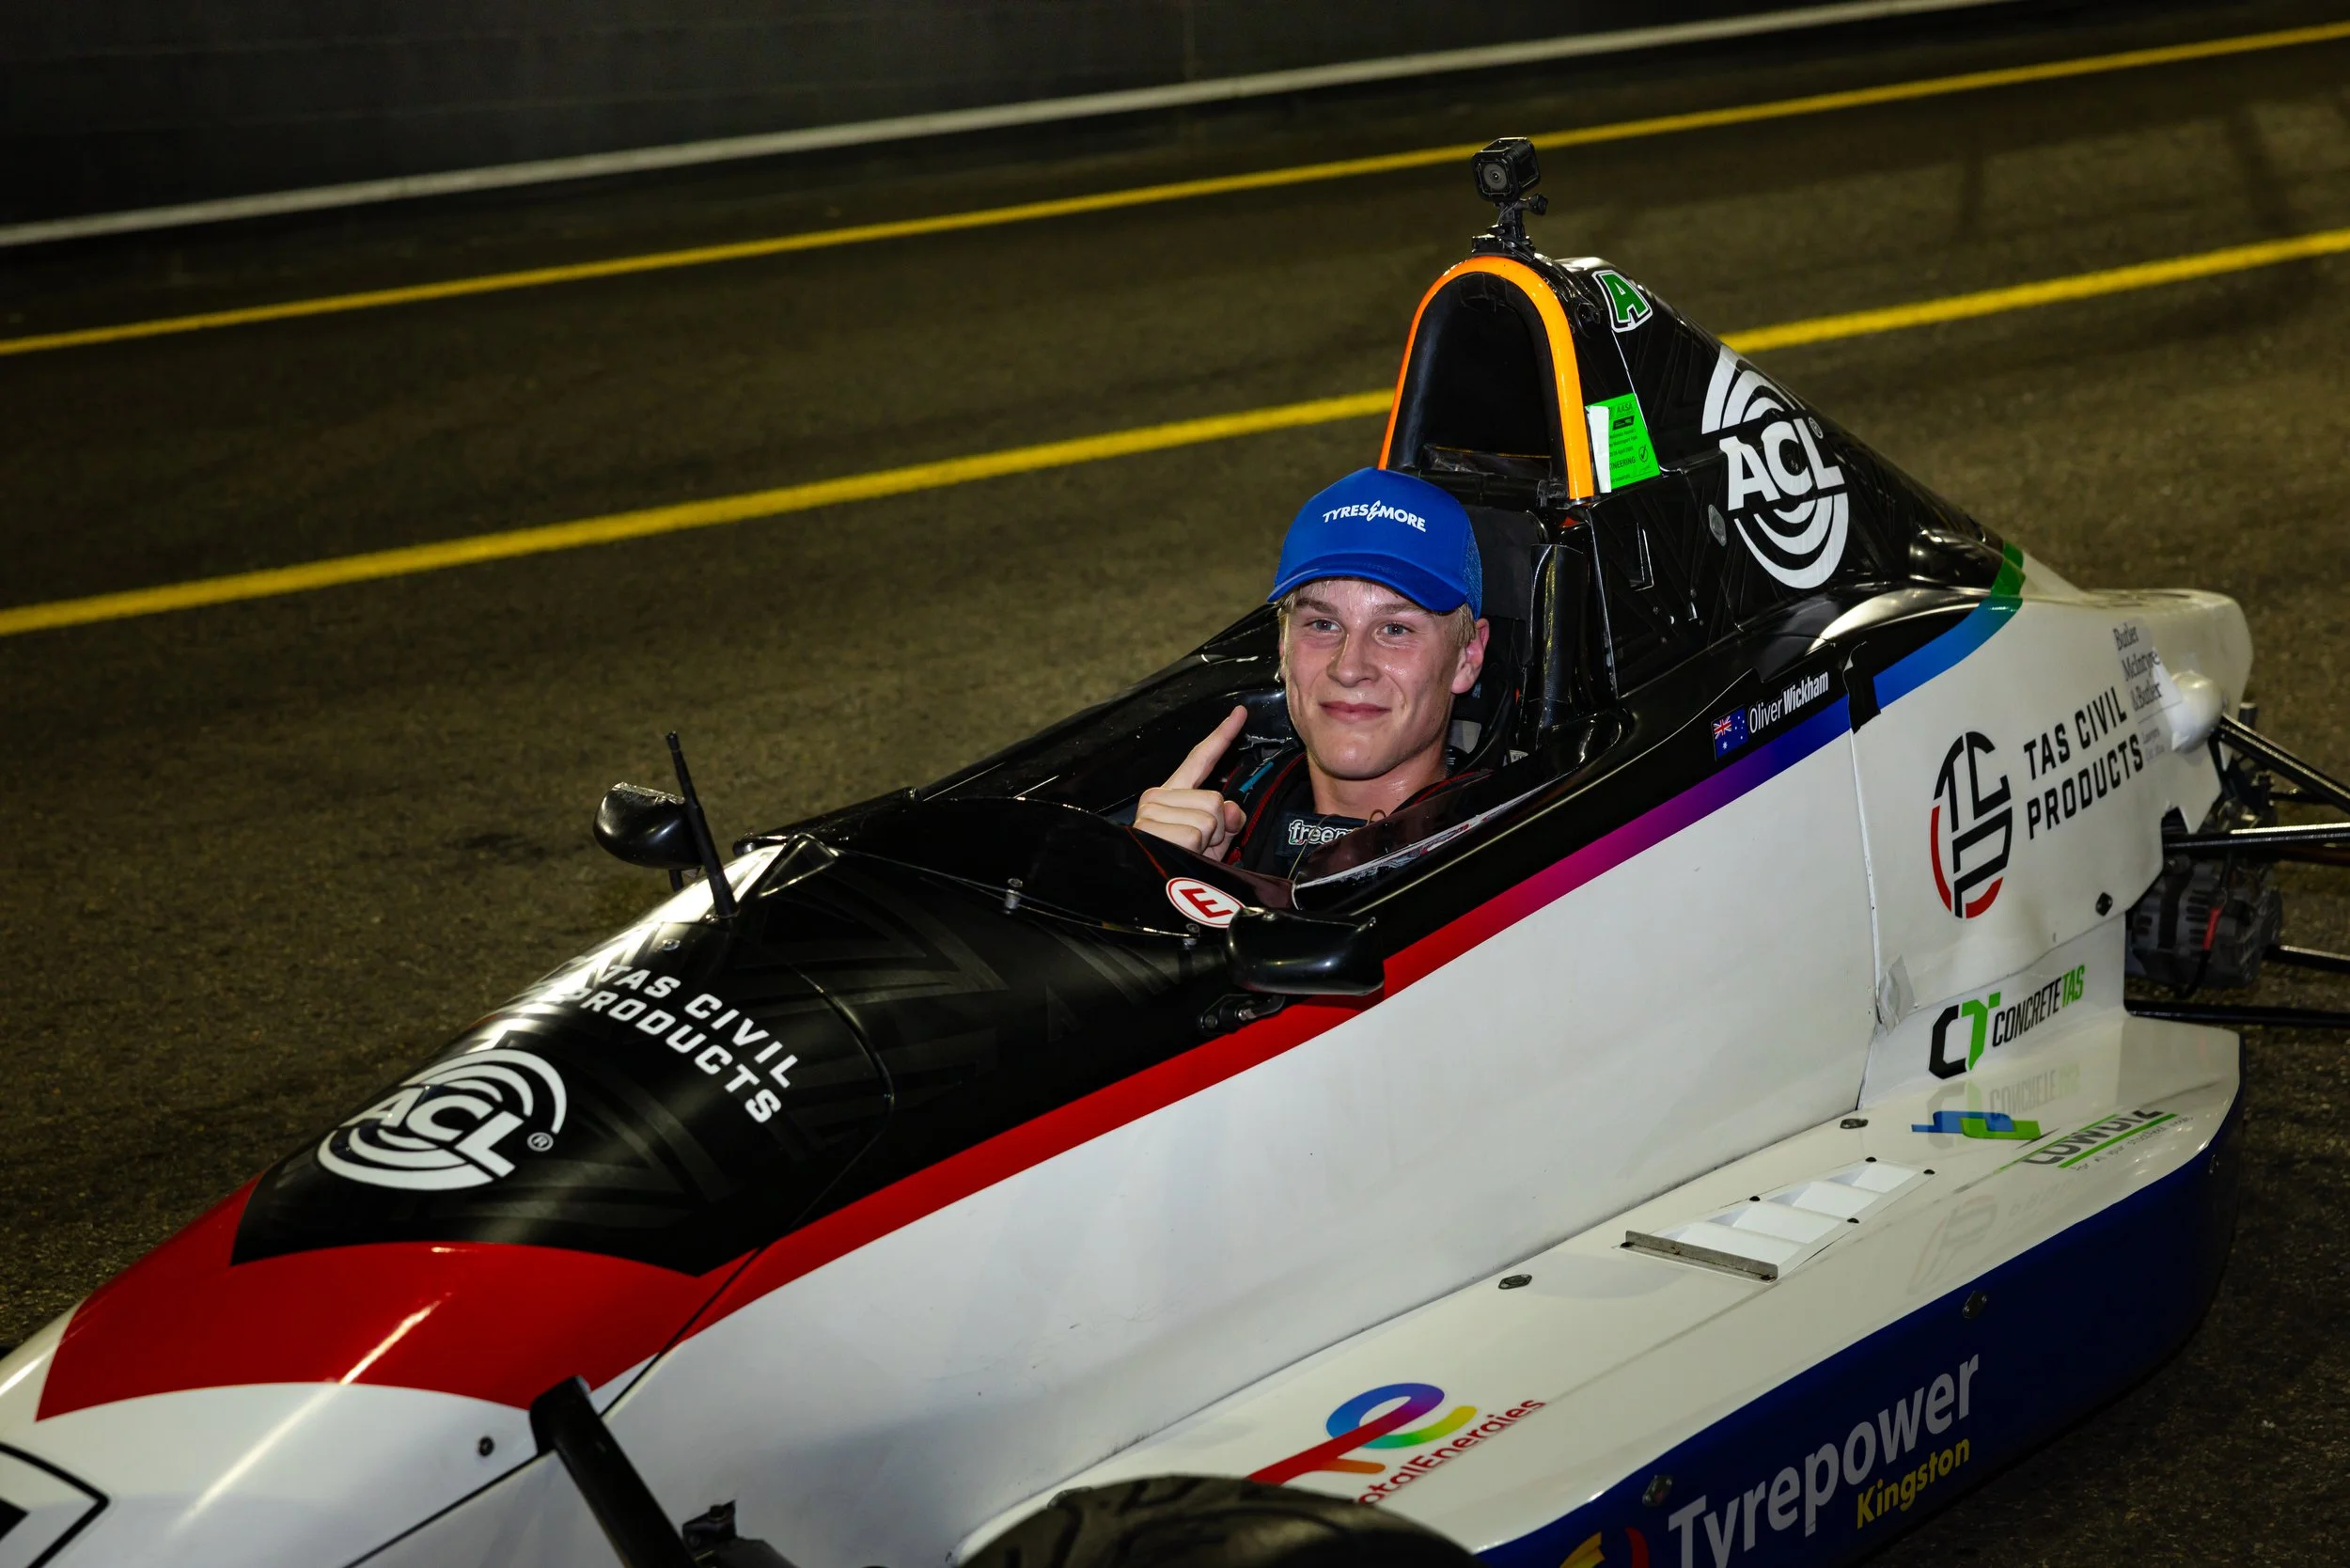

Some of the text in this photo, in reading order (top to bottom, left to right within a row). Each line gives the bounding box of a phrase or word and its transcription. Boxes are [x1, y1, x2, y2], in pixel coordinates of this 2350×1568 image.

[1597, 271, 1651, 327] A
[1718, 417, 1845, 511] ACL
[2113, 622, 2139, 651] Butler
[2122, 650, 2161, 682] McIntyre
[1749, 670, 1829, 734] Oliver Wickham
[2024, 686, 2127, 780] TAS CIVIL
[2027, 733, 2144, 840] PRODUCTS
[1179, 887, 1233, 918] E
[556, 987, 782, 1124] PRODUCTS
[600, 964, 799, 1089] TAS CIVIL
[338, 1087, 525, 1179] ACL
[1357, 1399, 1546, 1505] otalEnergies
[1668, 1354, 1980, 1568] Tyrepower
[1857, 1438, 1971, 1529] Kingston
